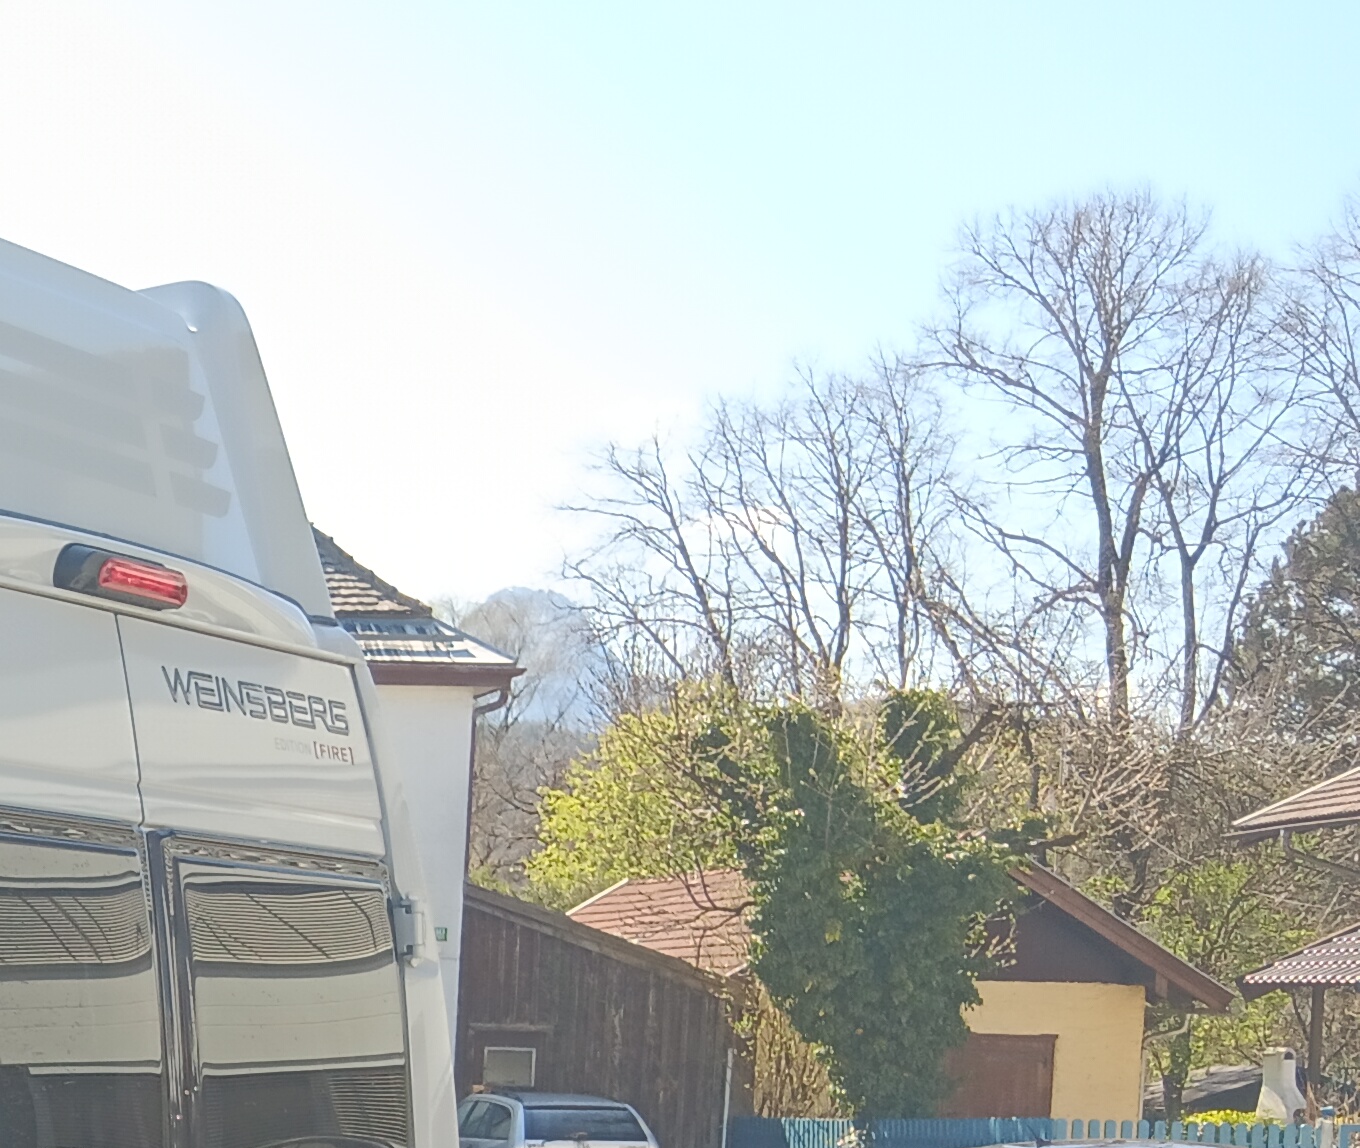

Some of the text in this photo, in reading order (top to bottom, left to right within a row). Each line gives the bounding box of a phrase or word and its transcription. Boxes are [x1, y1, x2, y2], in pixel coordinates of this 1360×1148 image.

[161, 665, 350, 736] WEINSBERG
[273, 737, 355, 765] EDITION [FIRE]
